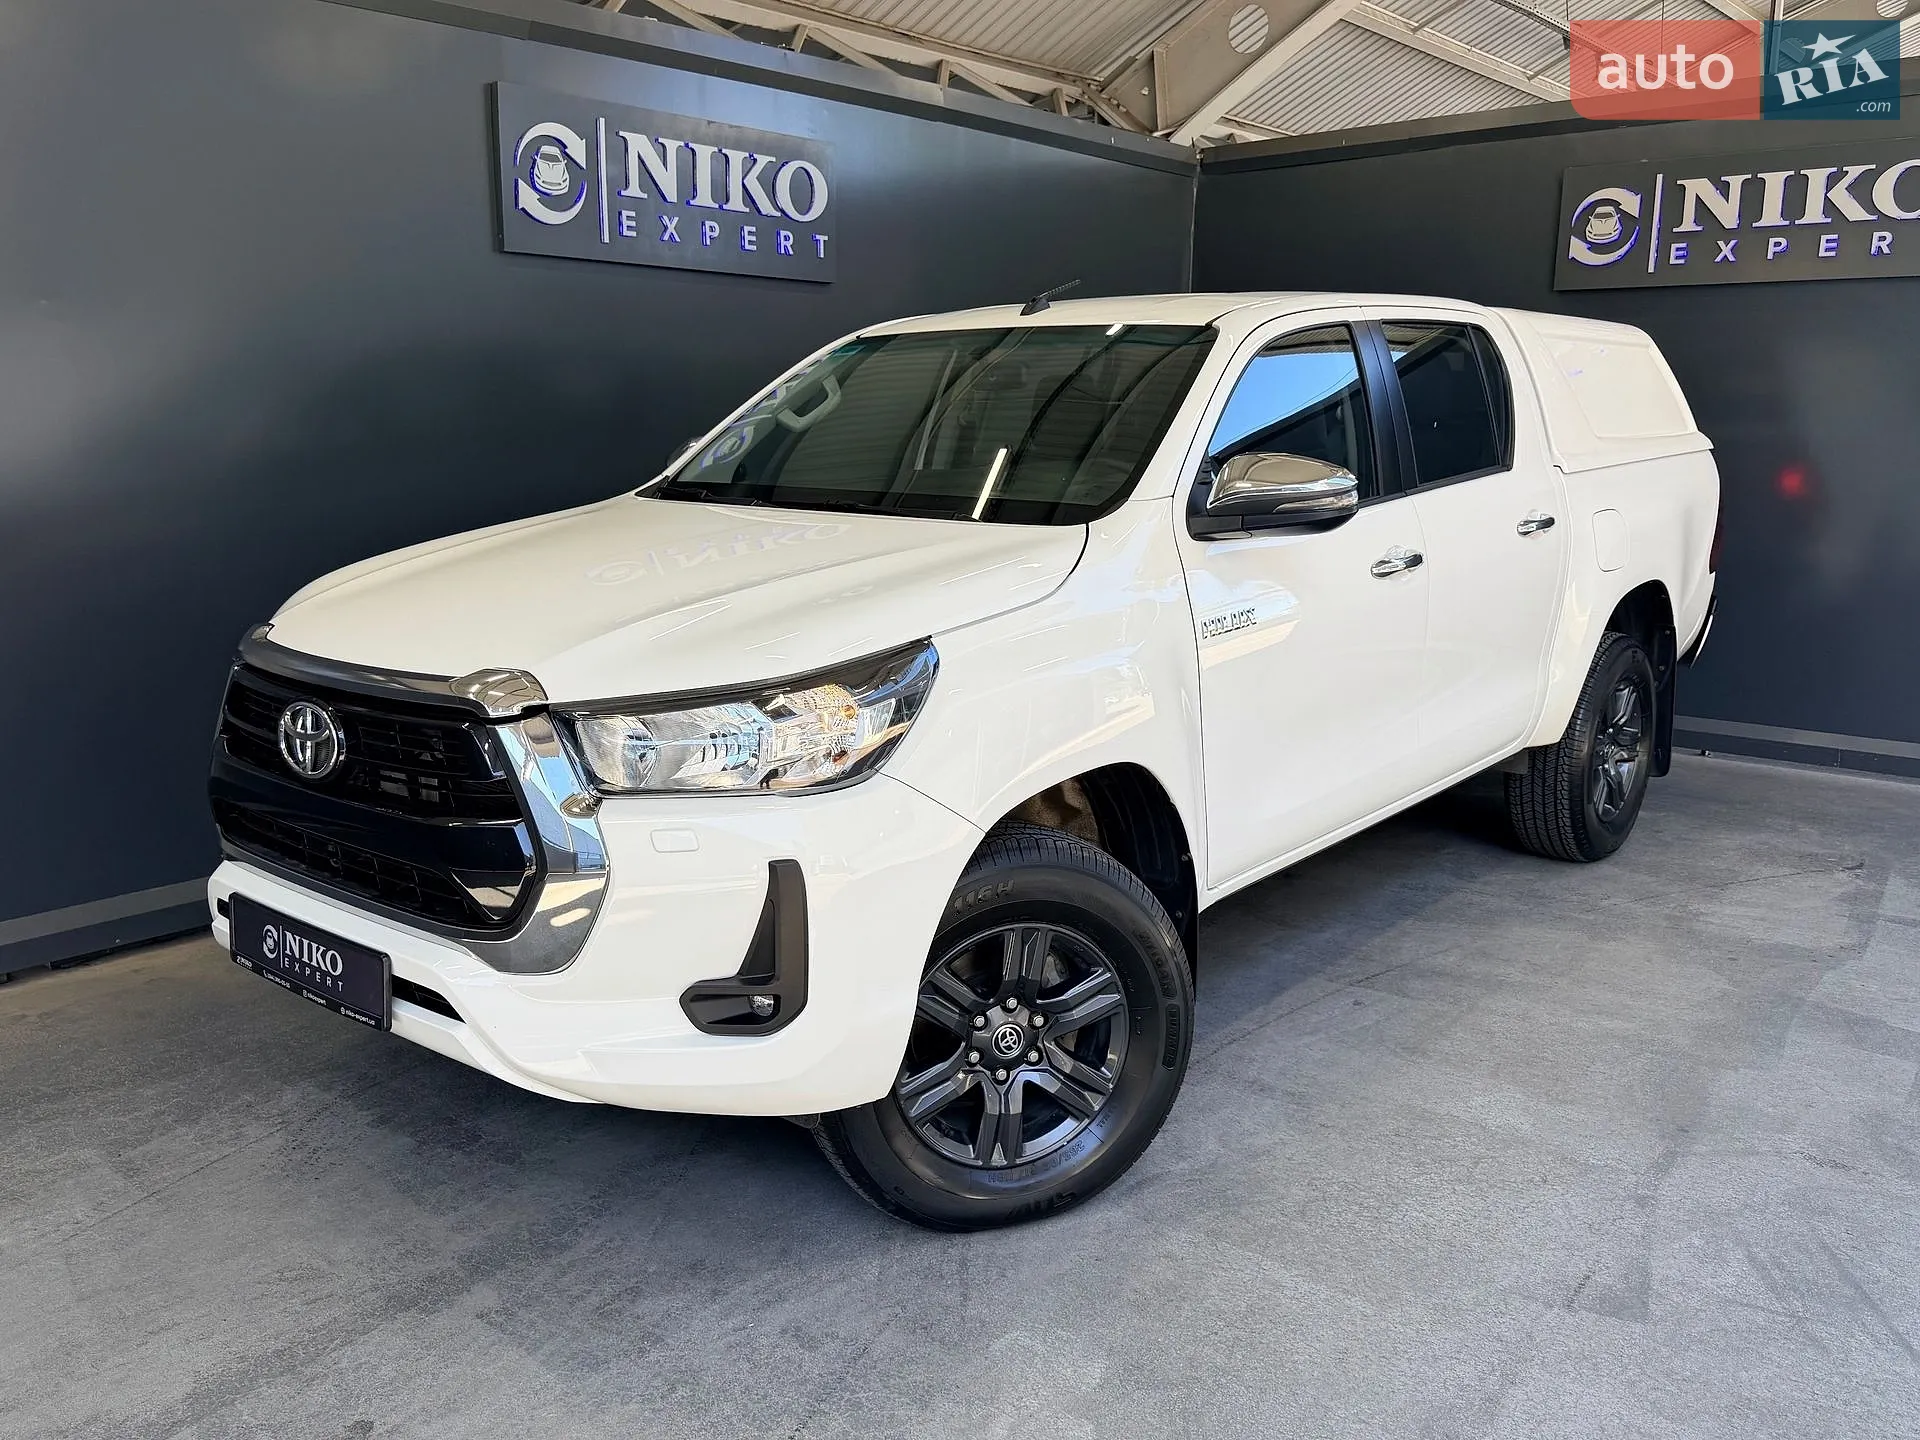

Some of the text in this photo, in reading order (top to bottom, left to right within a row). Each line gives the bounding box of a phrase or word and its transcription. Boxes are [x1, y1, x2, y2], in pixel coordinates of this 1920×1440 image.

[616, 130, 828, 222] NIKO
[1672, 159, 1920, 233] NIKO
[618, 210, 829, 258] EXPERT
[284, 930, 343, 976] NIKO
[284, 957, 344, 992] EXPERT
